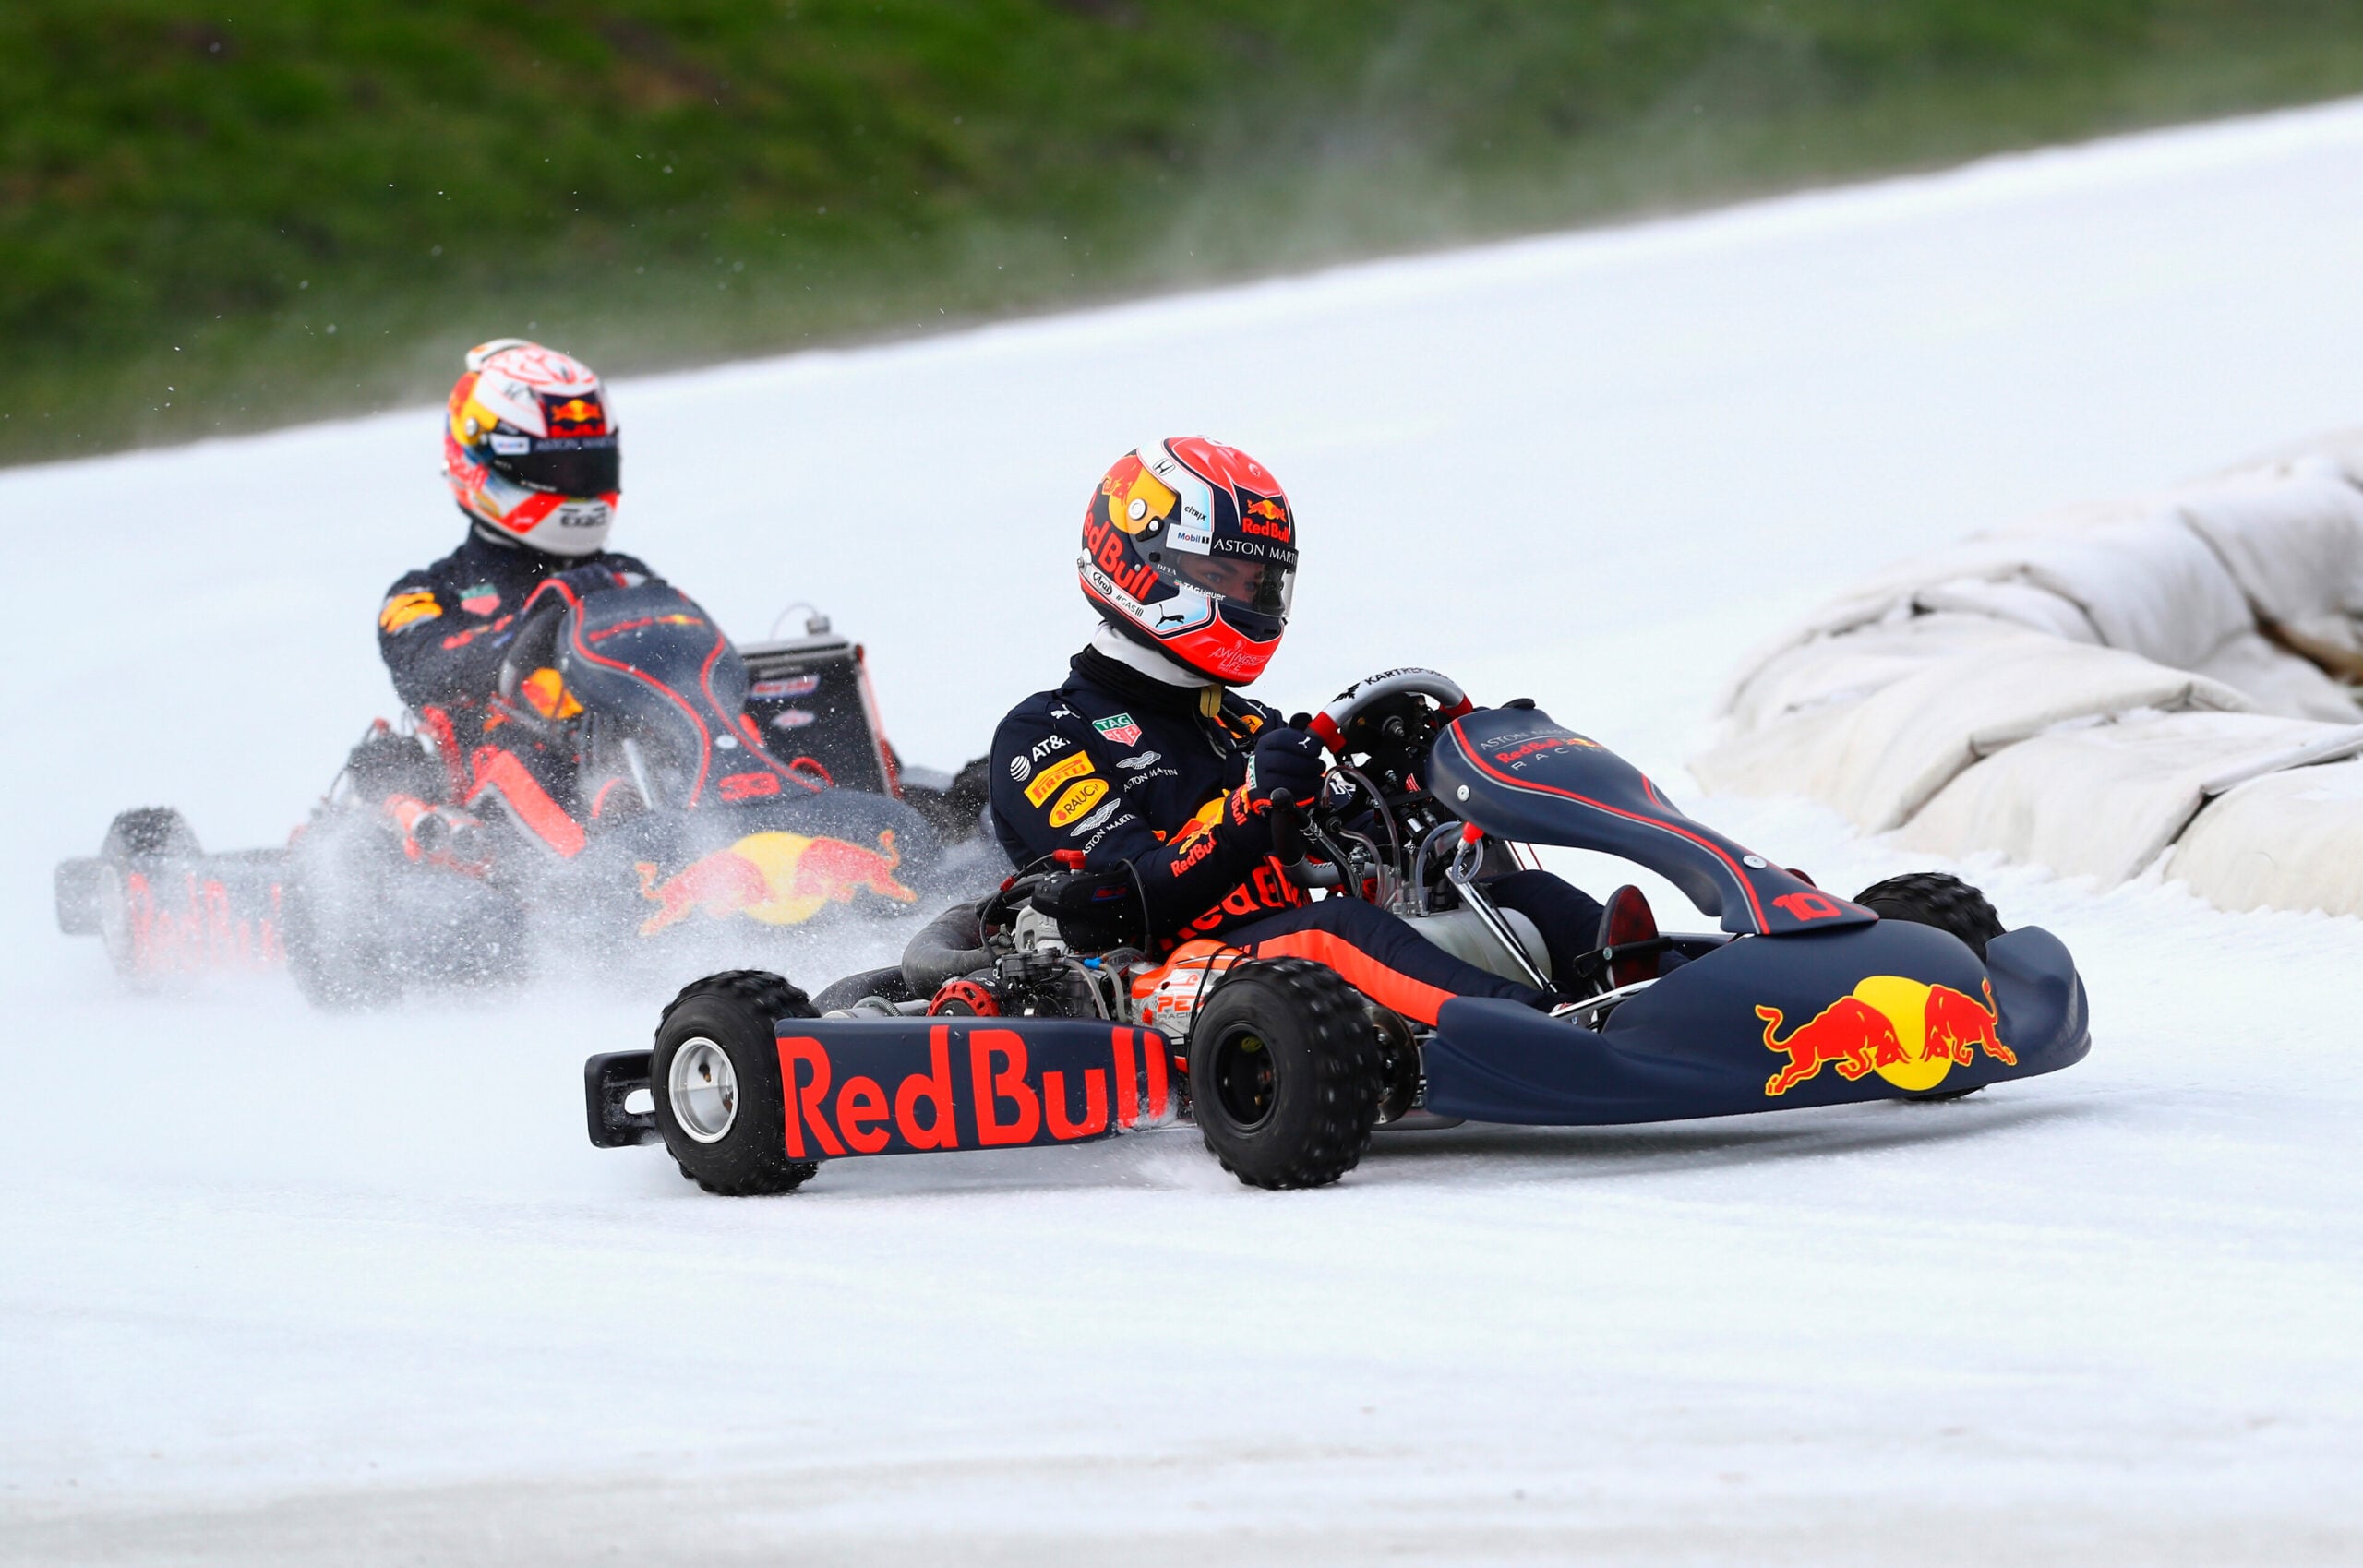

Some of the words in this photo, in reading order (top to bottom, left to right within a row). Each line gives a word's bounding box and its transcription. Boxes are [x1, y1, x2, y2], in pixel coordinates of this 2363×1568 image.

[1177, 532, 1201, 543] Mobil
[1202, 535, 1210, 545] 1
[1242, 517, 1269, 536] Red
[1270, 521, 1289, 543] Bull
[1213, 538, 1265, 557] ASTON
[1269, 546, 1297, 567] MARTI
[1098, 532, 1159, 603] Bull
[1157, 563, 1177, 576] DITA
[1095, 575, 1112, 593] Arai
[1182, 581, 1200, 593] TAG
[1199, 588, 1226, 601] Heuer
[1096, 715, 1131, 729] TAG
[1480, 732, 1529, 750] ASTON
[1123, 773, 1149, 792] ASTON
[1149, 767, 1179, 777] MATIN
[1082, 828, 1106, 856] ASTON
[1170, 851, 1197, 877] Red
[1771, 892, 1842, 921] 10
[775, 1024, 959, 1157] Red
[968, 1026, 1170, 1146] Bull
